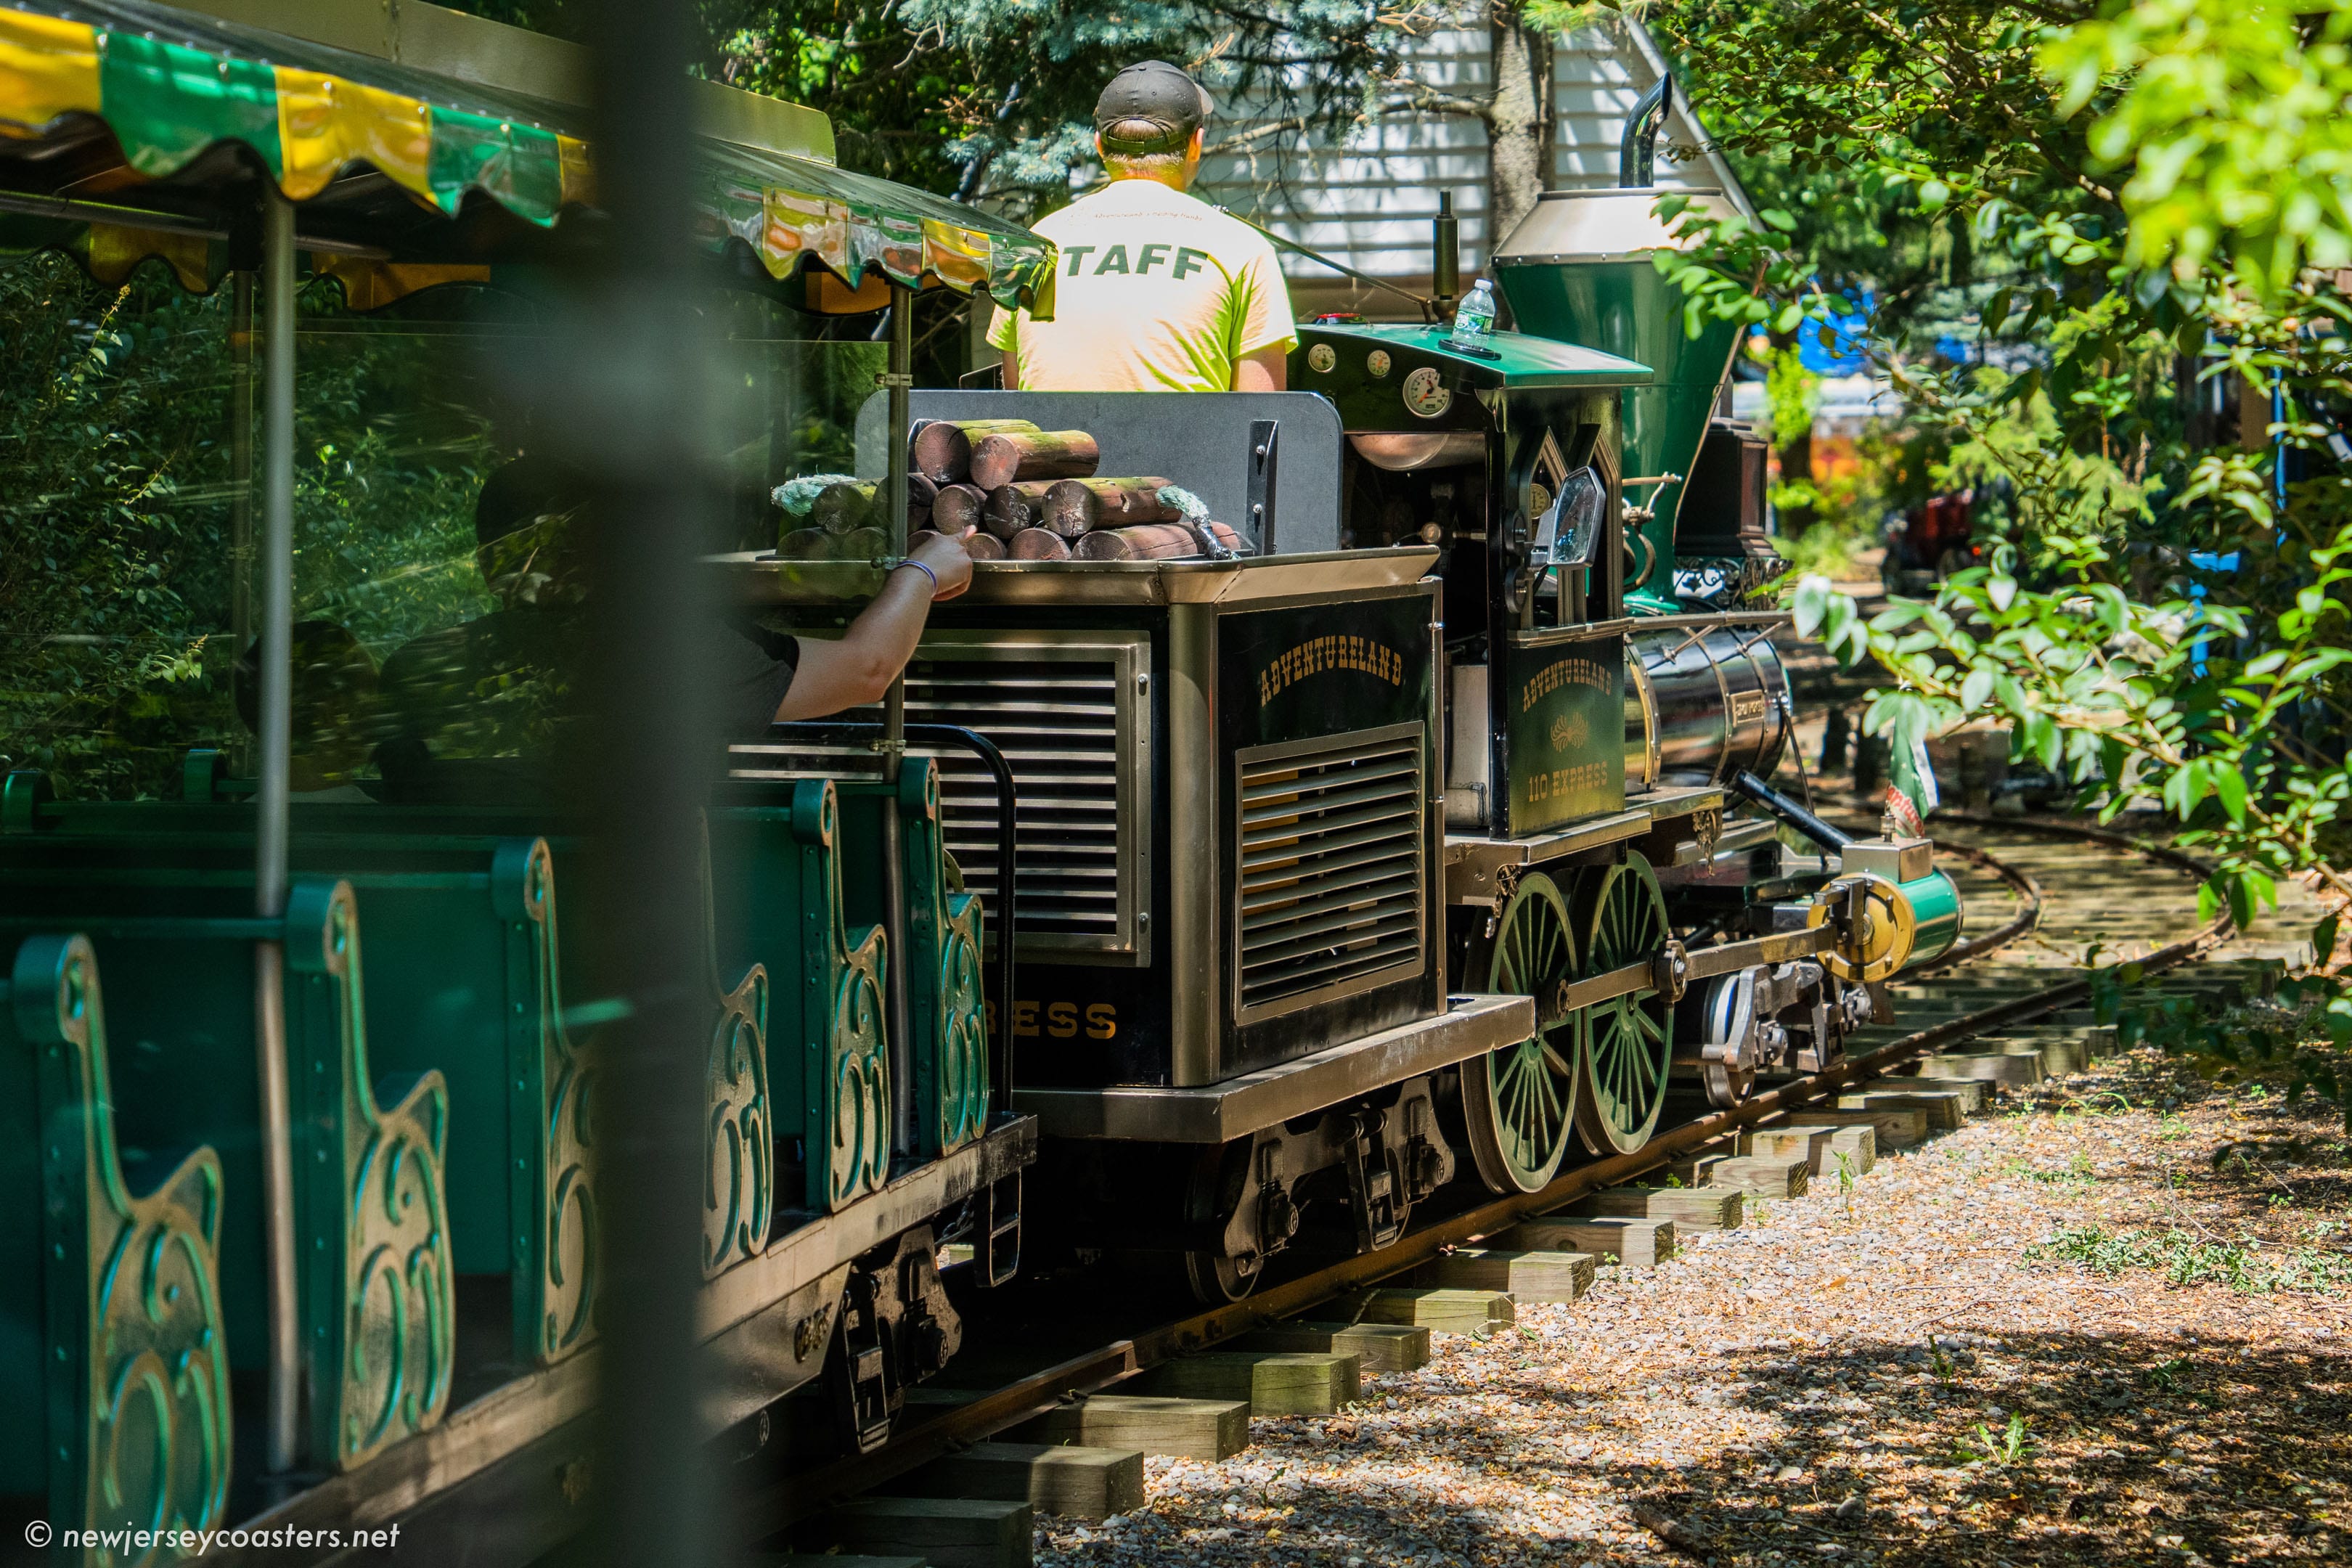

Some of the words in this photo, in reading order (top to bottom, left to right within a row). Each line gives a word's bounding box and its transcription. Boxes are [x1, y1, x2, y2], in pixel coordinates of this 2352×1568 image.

[1063, 244, 1208, 280] TAFF
[1261, 635, 1402, 708] ADVENTURELAND
[1523, 658, 1612, 713] ADVENTURELAND
[1529, 773, 1548, 802] 110
[1552, 761, 1608, 796] EXPRESS
